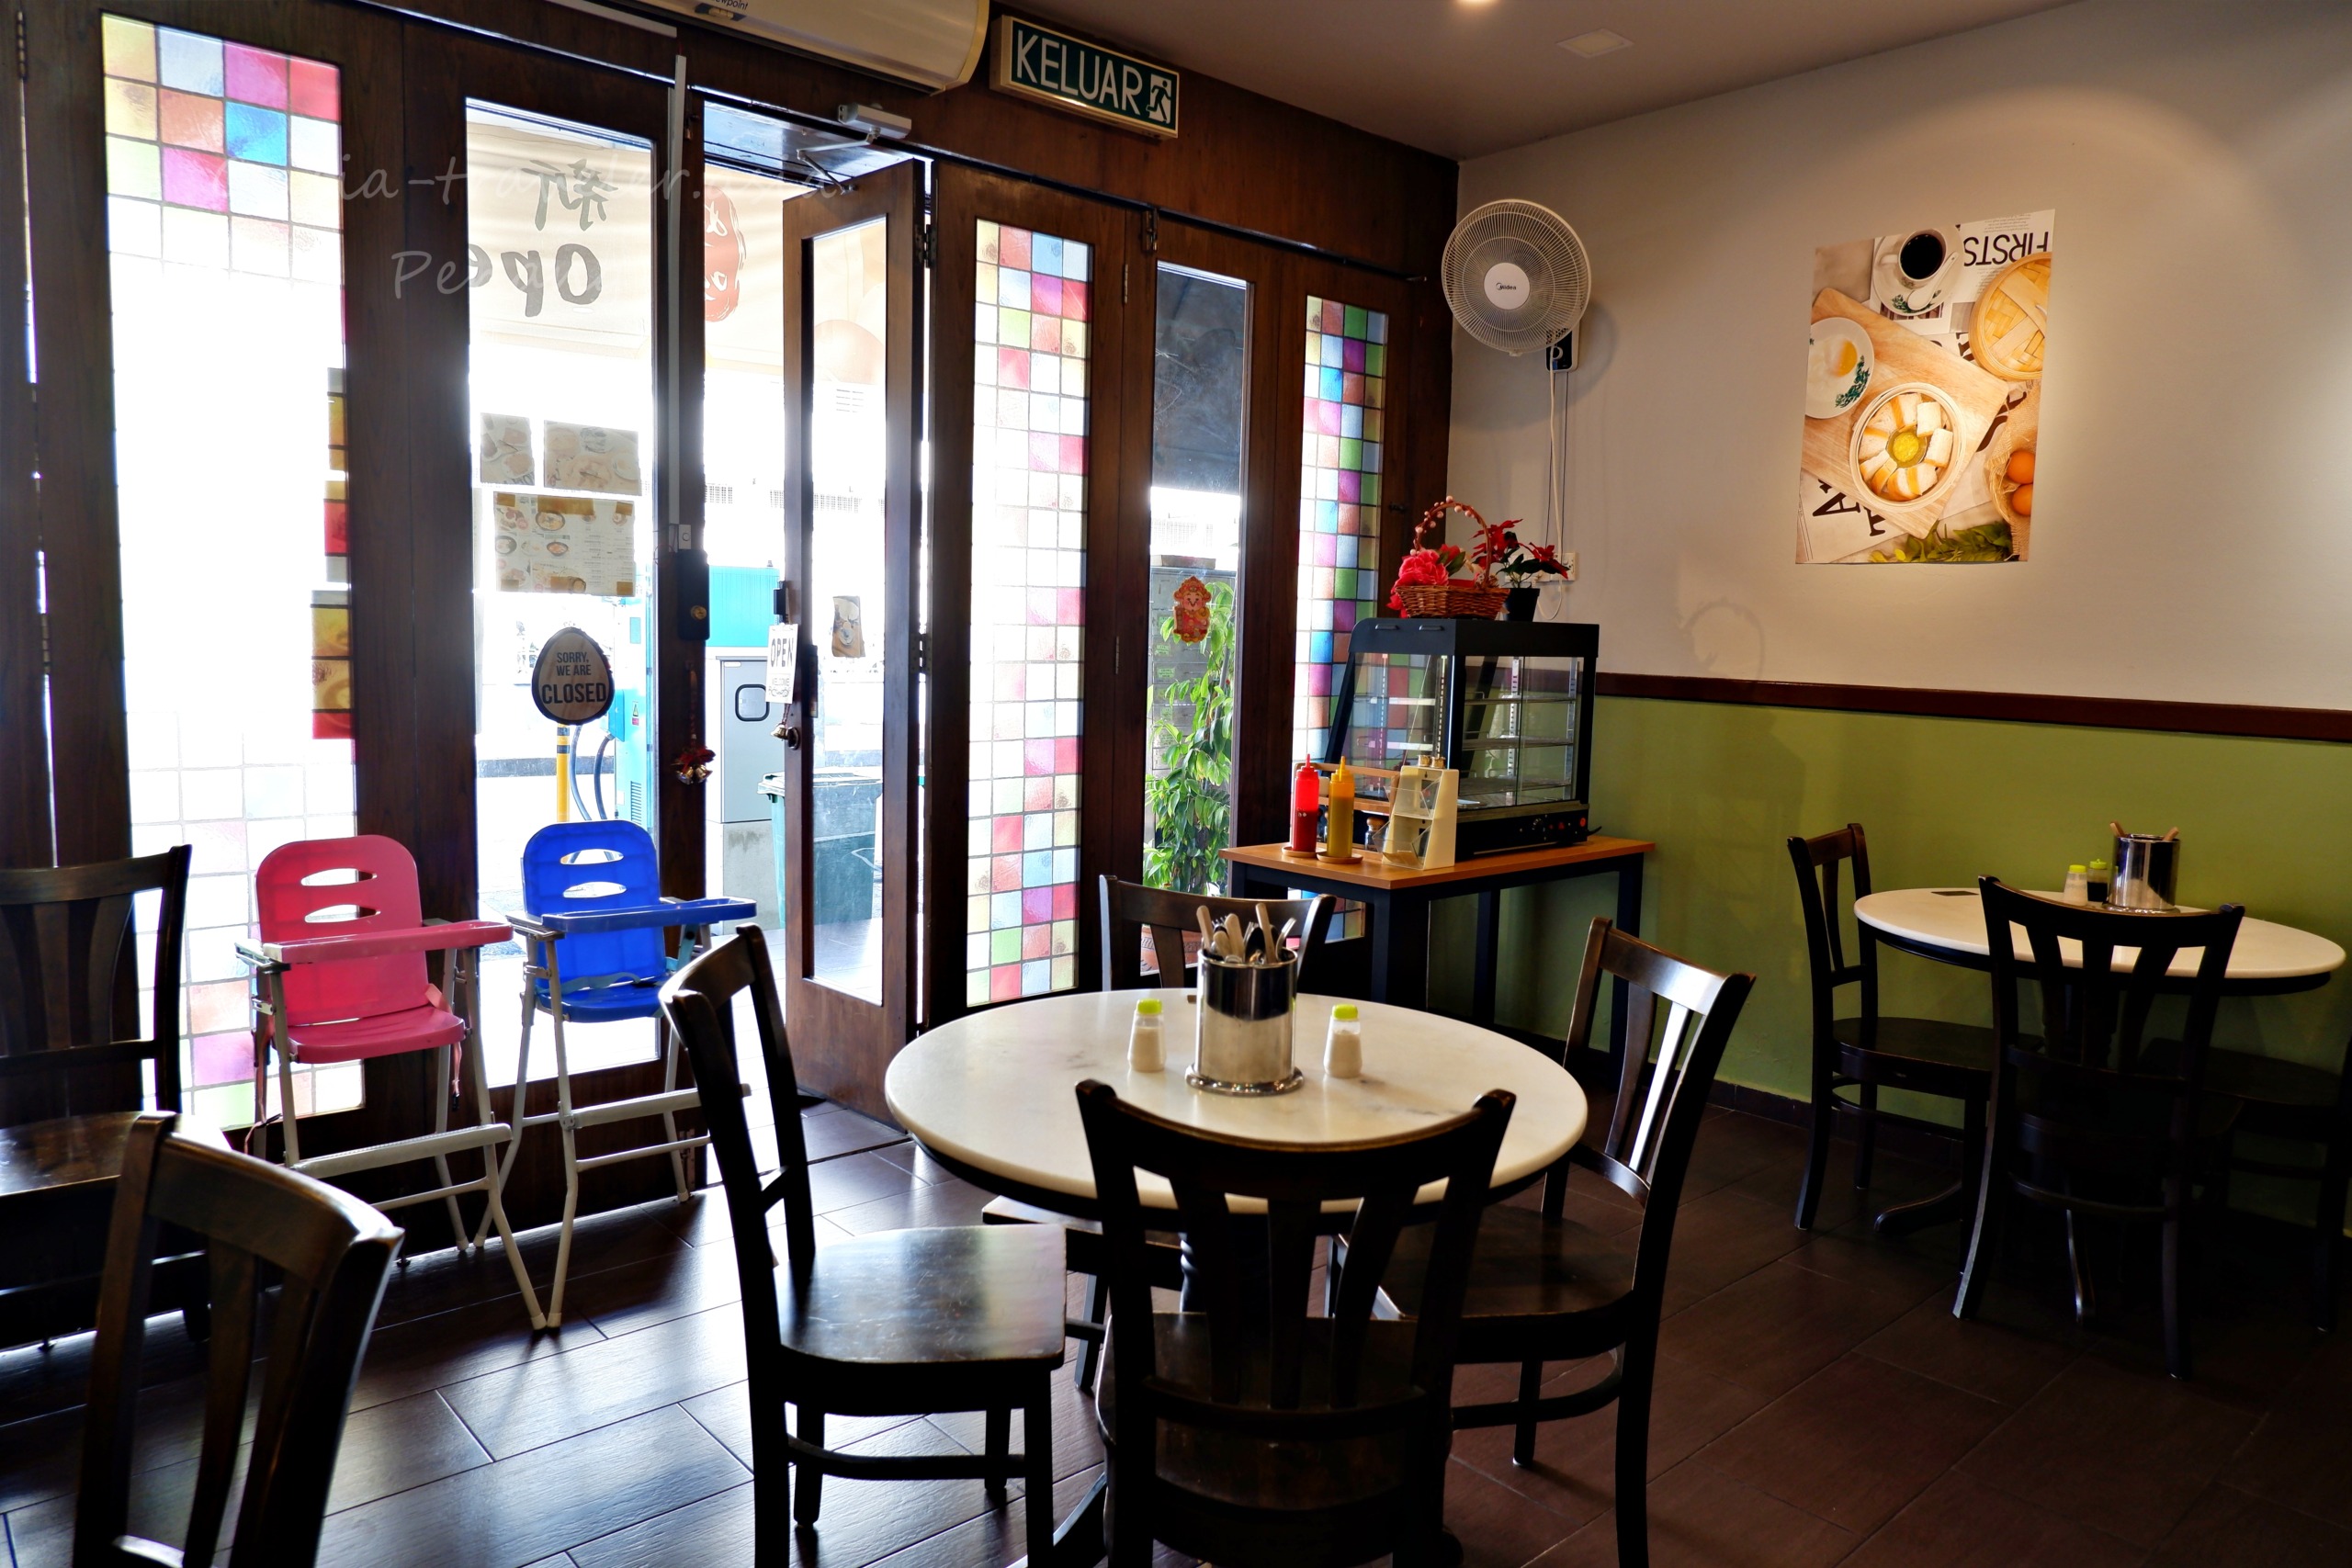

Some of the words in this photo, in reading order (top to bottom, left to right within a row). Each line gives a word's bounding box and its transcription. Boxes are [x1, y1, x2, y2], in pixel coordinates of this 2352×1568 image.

[1016, 29, 1141, 116] KELUAR
[1496, 282, 1517, 291] Midea
[556, 651, 590, 663] SORRY,
[771, 637, 794, 668] OPEN
[556, 665, 571, 676] WE
[573, 664, 592, 676] ARE
[541, 682, 606, 705] CLOSED
